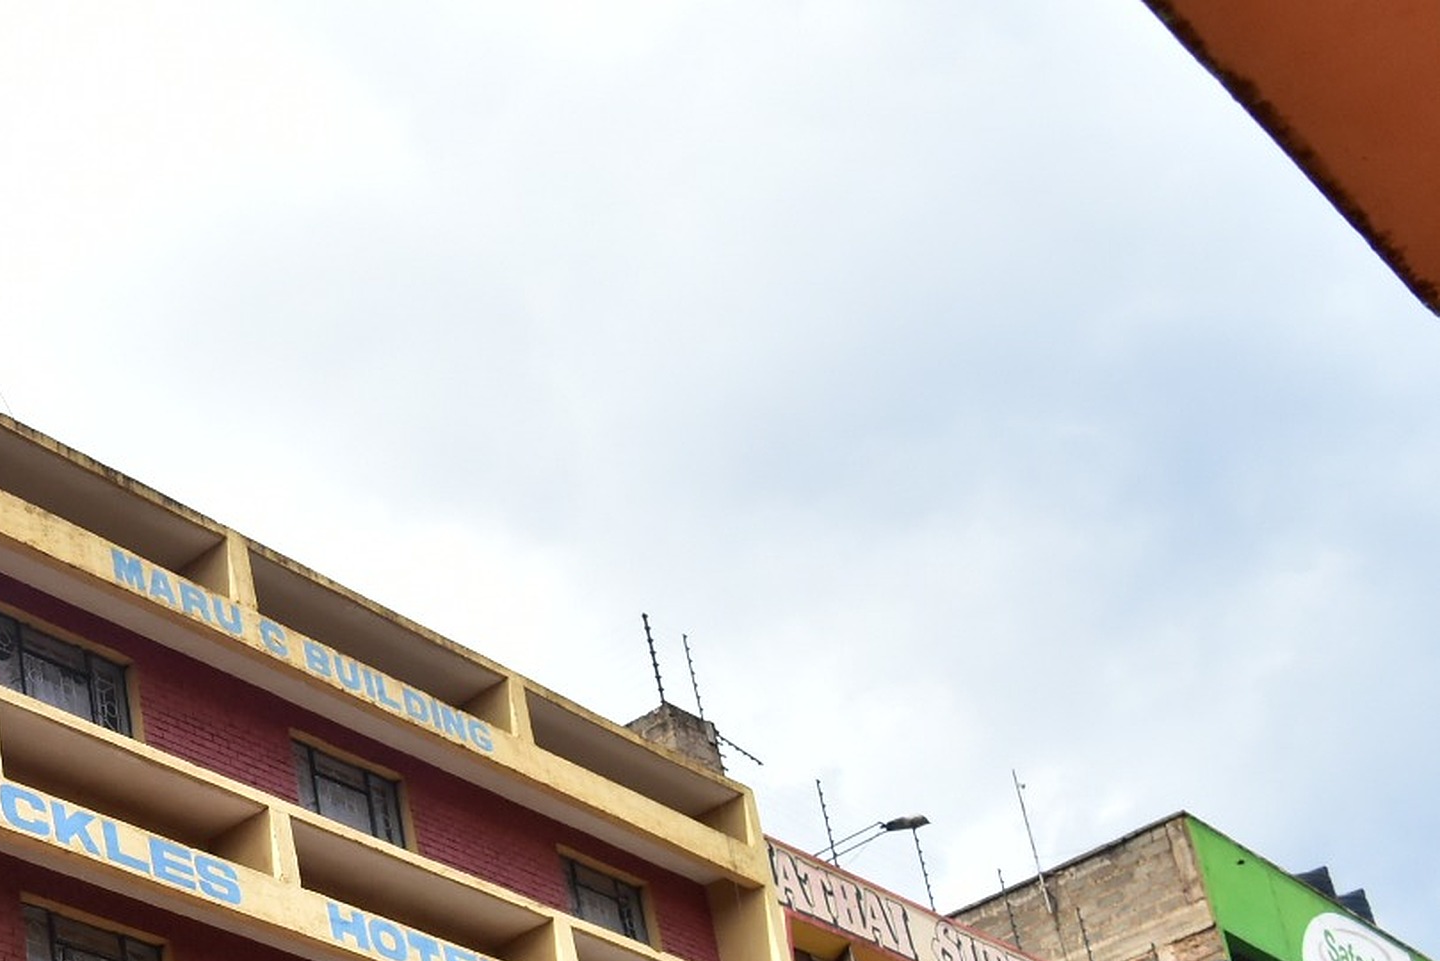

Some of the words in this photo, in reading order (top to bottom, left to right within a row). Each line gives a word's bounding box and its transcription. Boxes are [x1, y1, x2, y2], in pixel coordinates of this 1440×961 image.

[111, 547, 244, 636] MARU
[303, 639, 495, 753] BUILDING
[767, 843, 920, 961] ATHAI
